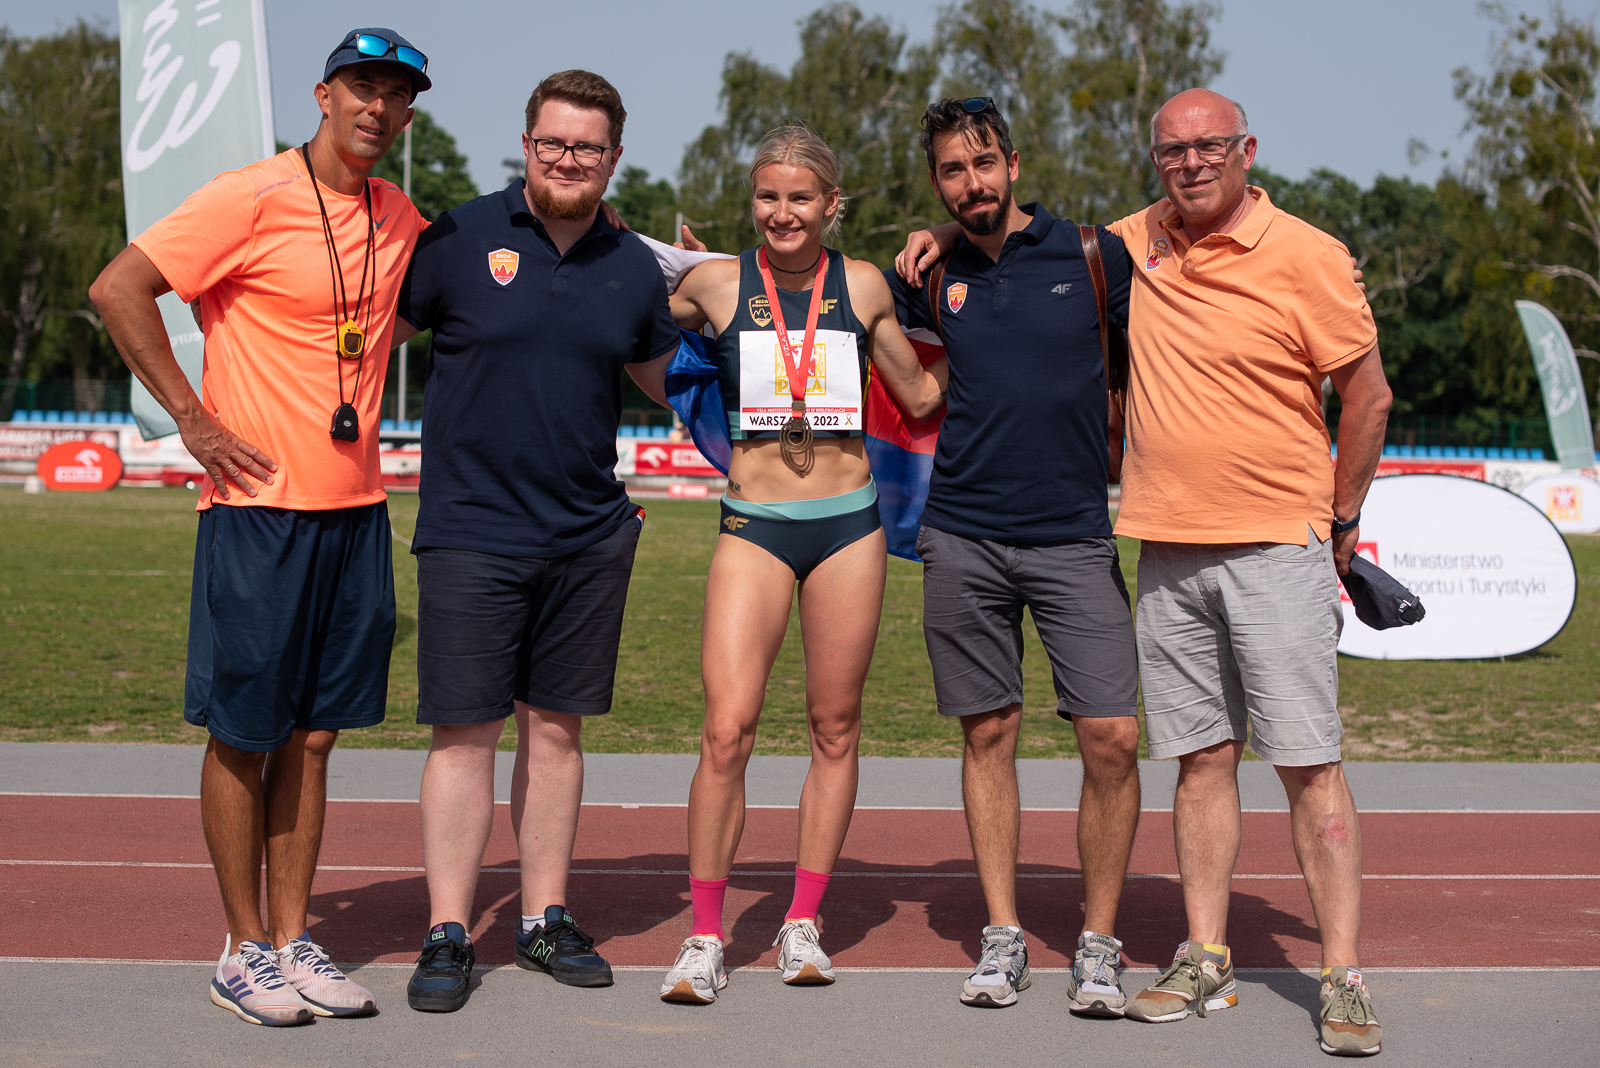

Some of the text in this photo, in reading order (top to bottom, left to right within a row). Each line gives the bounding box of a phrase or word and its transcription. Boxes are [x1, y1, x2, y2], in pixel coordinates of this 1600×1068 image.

[1051, 284, 1072, 294] 4F
[781, 336, 790, 356] PZLA
[813, 415, 839, 426] 2022
[723, 515, 750, 531] 4F
[1393, 552, 1504, 570] Ministerstwo
[1459, 577, 1465, 594] i
[1467, 577, 1547, 598] Turystyki
[1090, 938, 1114, 949] balance
